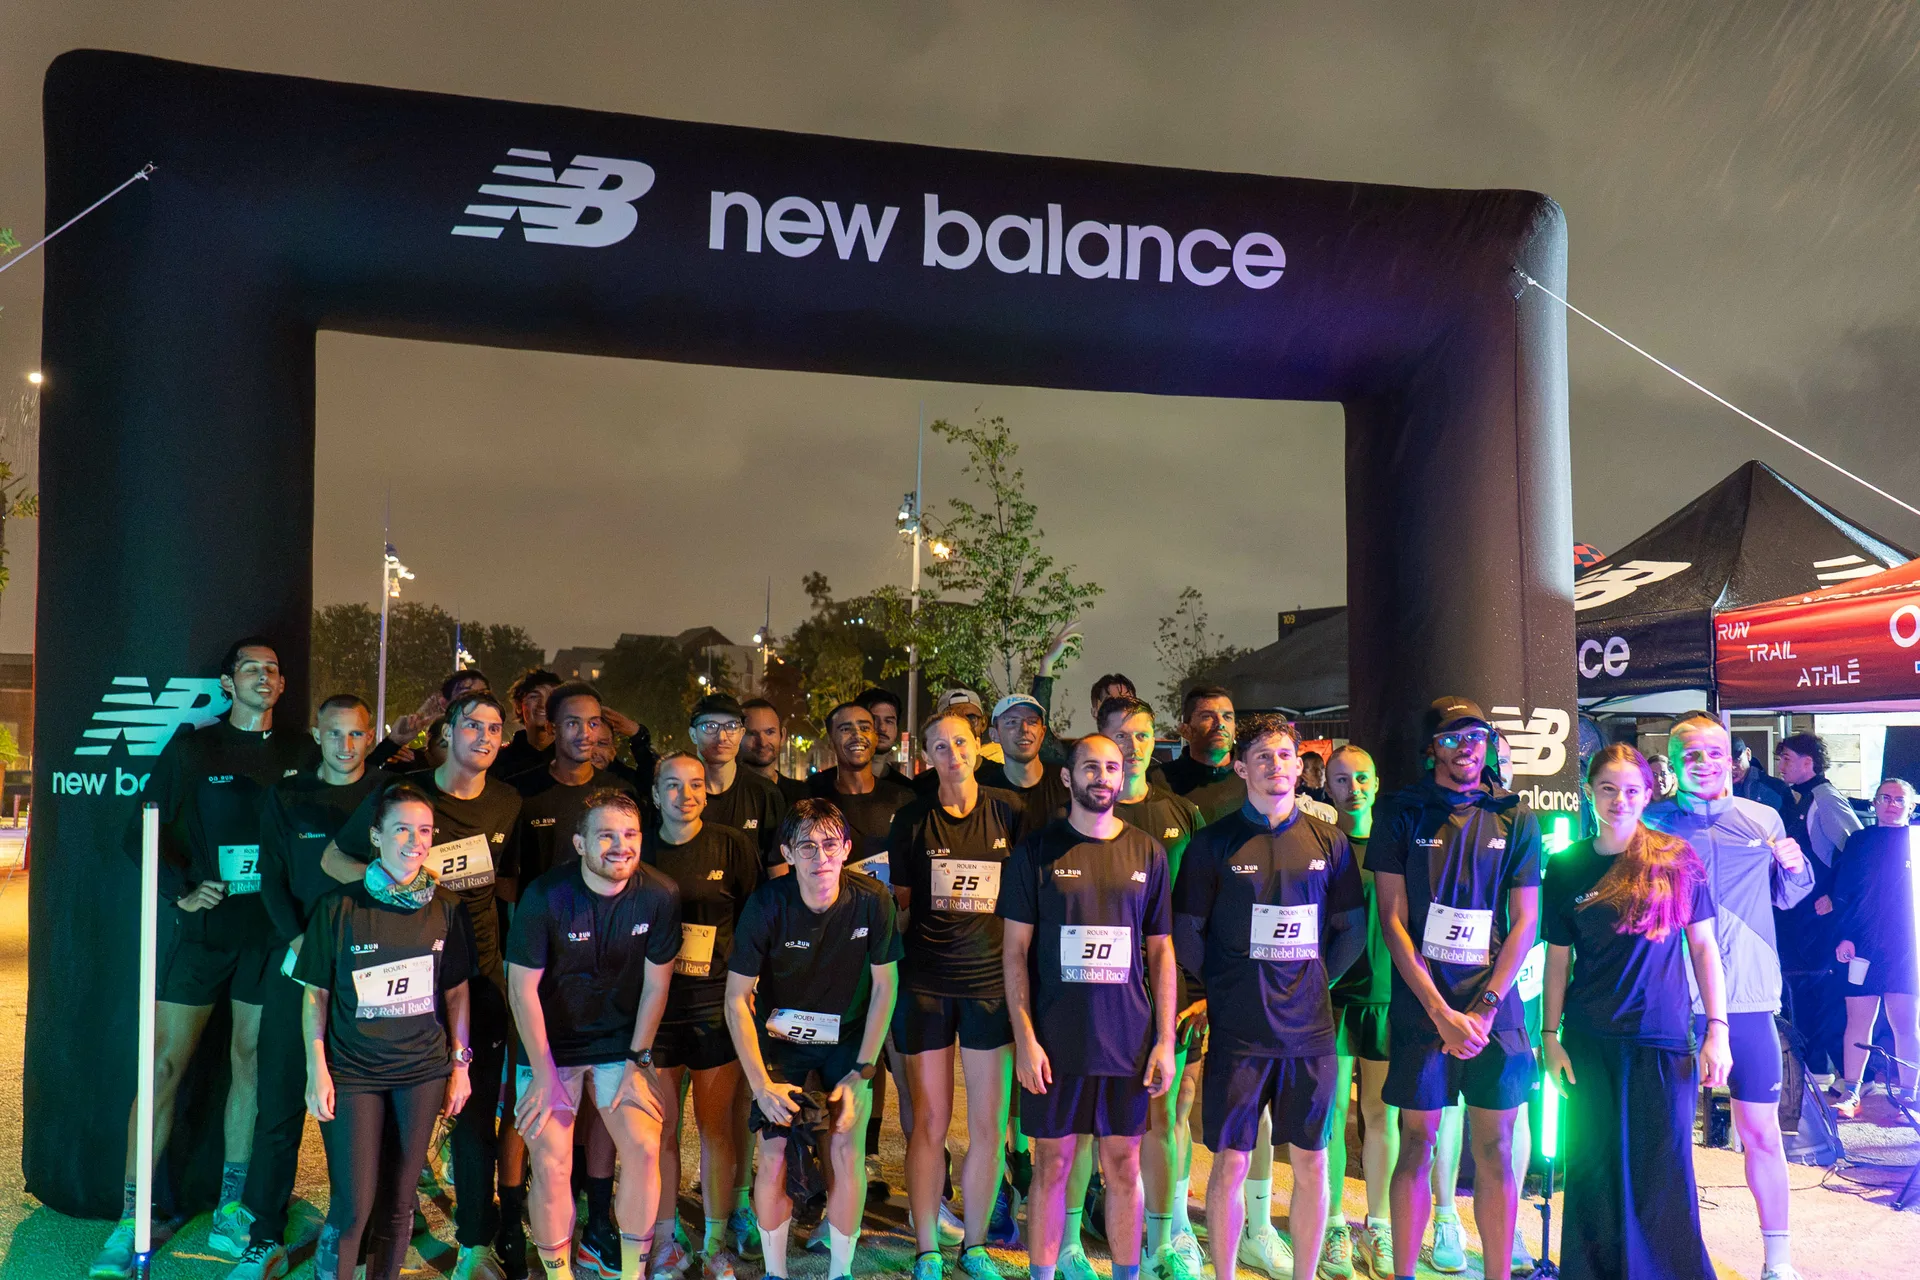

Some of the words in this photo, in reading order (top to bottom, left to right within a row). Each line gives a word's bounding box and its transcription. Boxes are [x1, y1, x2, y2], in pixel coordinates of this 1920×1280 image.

[450, 147, 656, 249] NB
[708, 189, 900, 264] new
[923, 192, 1287, 290] balance
[1717, 621, 1750, 641] RUN
[1746, 641, 1797, 663] TRAIL
[1796, 658, 1861, 688] ATHLÉ
[52, 771, 108, 796] new
[1517, 785, 1580, 812] alance
[439, 843, 462, 853] ROUEN
[1487, 838, 1506, 850] NB
[442, 855, 468, 876] 23
[1308, 859, 1326, 871] NB
[467, 874, 490, 888] Race
[706, 869, 725, 881] NB
[1130, 870, 1147, 883] NB
[952, 875, 980, 891] 25
[949, 898, 972, 910] Rebel
[631, 923, 649, 936] NB
[850, 927, 869, 940] NB
[1273, 922, 1301, 939] 29
[1445, 924, 1474, 942] 34
[363, 943, 379, 951] RUN
[797, 940, 810, 948] RUN
[1081, 943, 1112, 960] 30
[1270, 947, 1294, 959] Rebel
[1426, 944, 1439, 959] SC
[1440, 948, 1465, 962] Rebel
[1466, 951, 1484, 962] Race
[383, 963, 408, 974] ROUEN
[1066, 968, 1078, 980] SC
[1080, 968, 1105, 980] Rebel
[386, 976, 410, 997] 18
[377, 1003, 406, 1016] Rebel
[793, 1013, 815, 1021] ROUEN
[787, 1025, 817, 1041] 22
